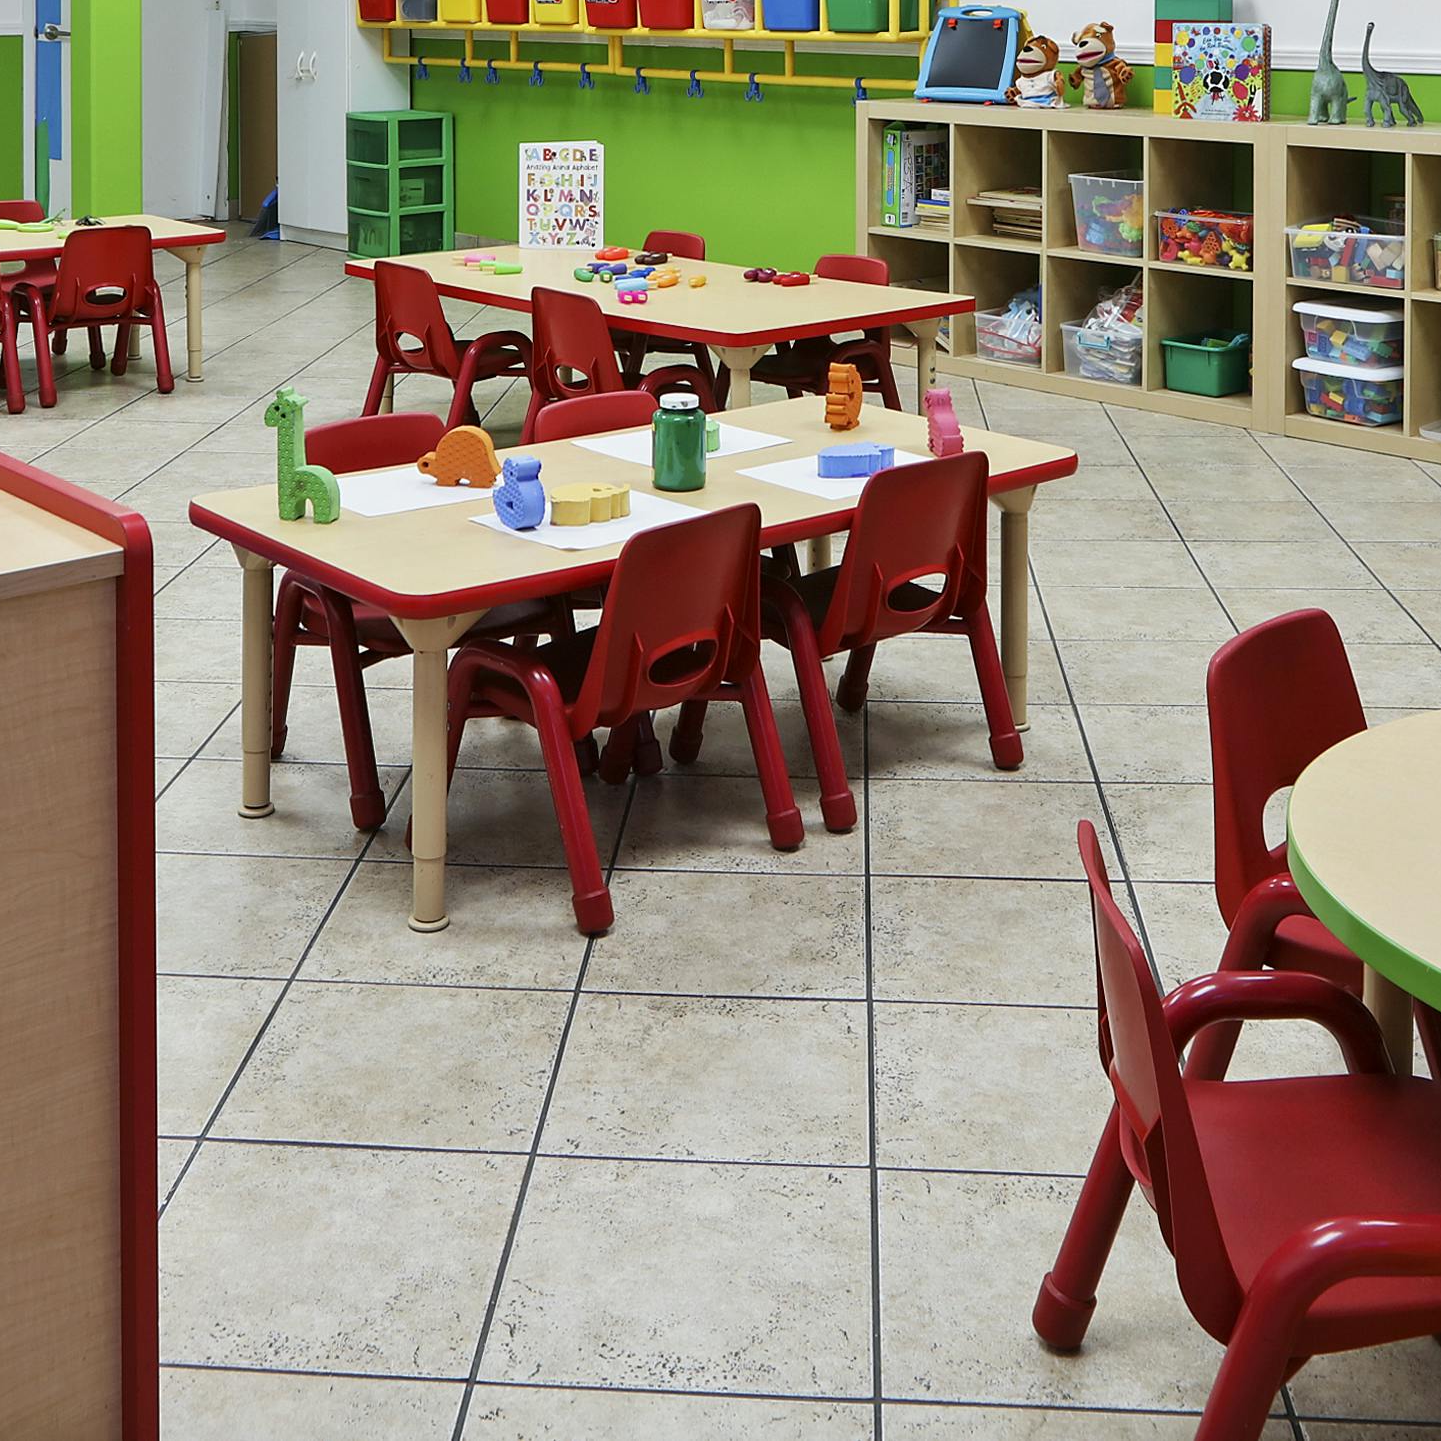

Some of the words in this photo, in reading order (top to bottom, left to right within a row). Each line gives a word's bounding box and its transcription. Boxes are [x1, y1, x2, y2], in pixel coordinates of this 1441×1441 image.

[543, 149, 552, 161] B
[573, 149, 583, 161] D
[589, 149, 597, 161] E
[572, 164, 599, 172] Alphabet
[528, 173, 535, 186] F
[561, 174, 573, 187] H
[580, 174, 584, 187] I
[590, 174, 597, 187] J
[527, 189, 538, 201] K
[544, 189, 551, 202] L
[559, 189, 573, 202] M
[580, 189, 593, 202] N
[527, 204, 539, 216] O
[560, 204, 573, 216] Q
[575, 205, 584, 217] R
[589, 205, 597, 217] S
[527, 218, 535, 230] T
[540, 219, 551, 231] U
[555, 218, 567, 231] V
[569, 218, 586, 231] W
[529, 231, 539, 244] X
[548, 232, 558, 245] Y
[566, 233, 576, 245] Z
